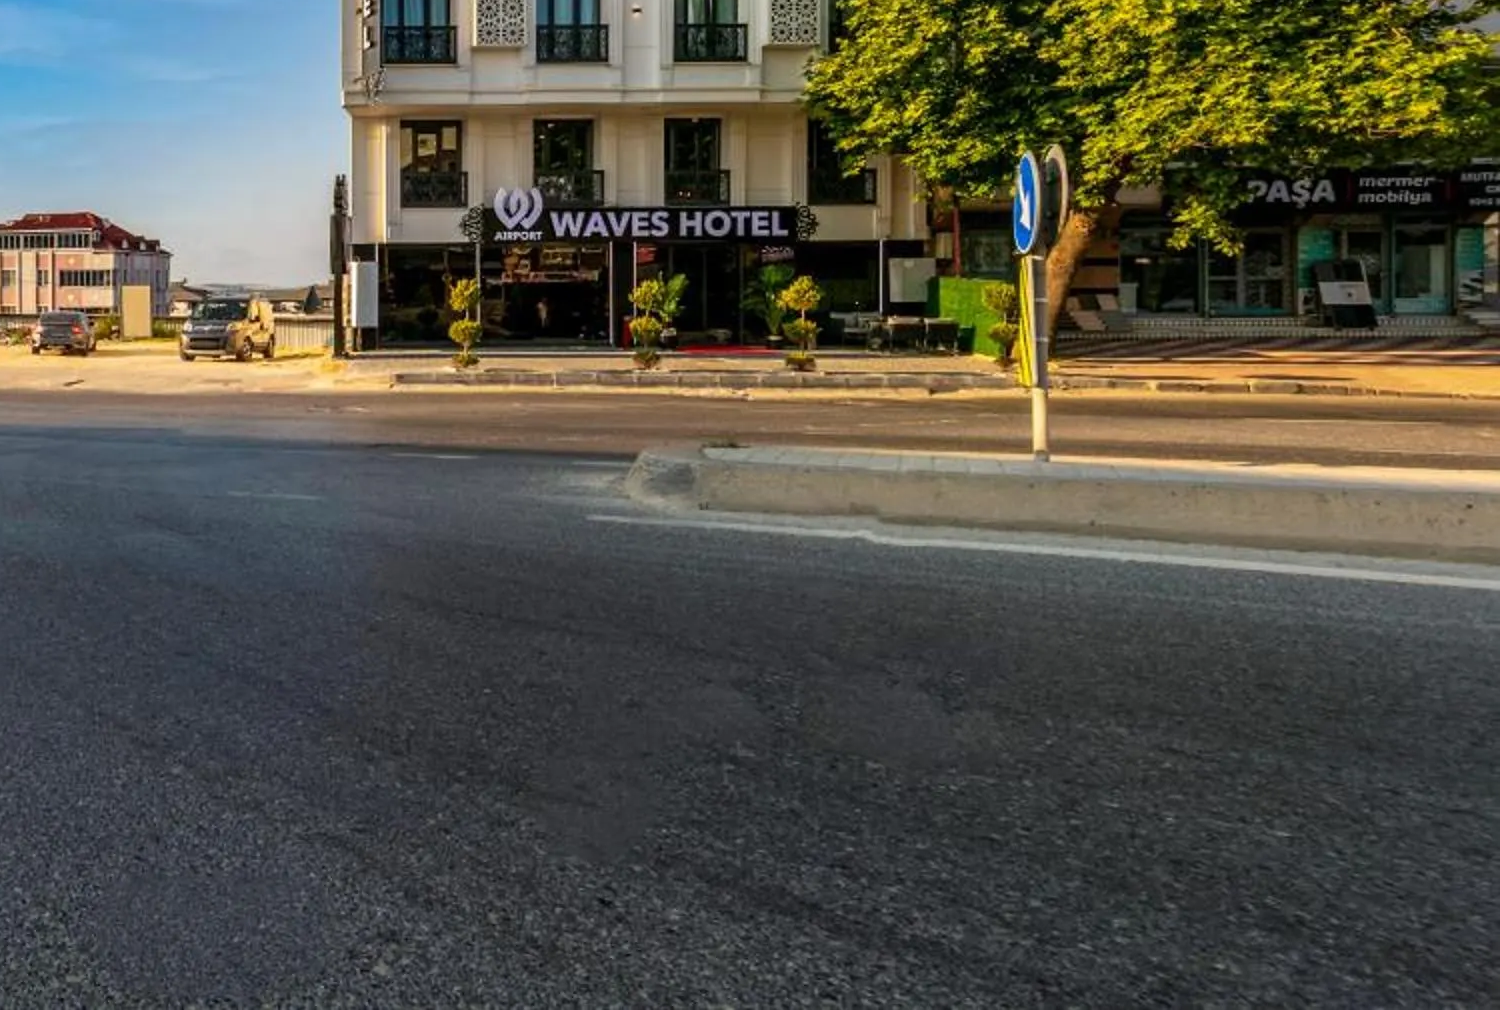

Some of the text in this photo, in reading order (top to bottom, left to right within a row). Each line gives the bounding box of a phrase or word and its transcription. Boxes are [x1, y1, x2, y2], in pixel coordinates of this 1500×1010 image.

[1358, 177, 1436, 188] mermer
[1247, 179, 1336, 209] PAŞA
[1358, 190, 1432, 205] mobilya
[550, 210, 789, 238] WAVES HOTEL
[494, 231, 543, 241] AIRPORT
